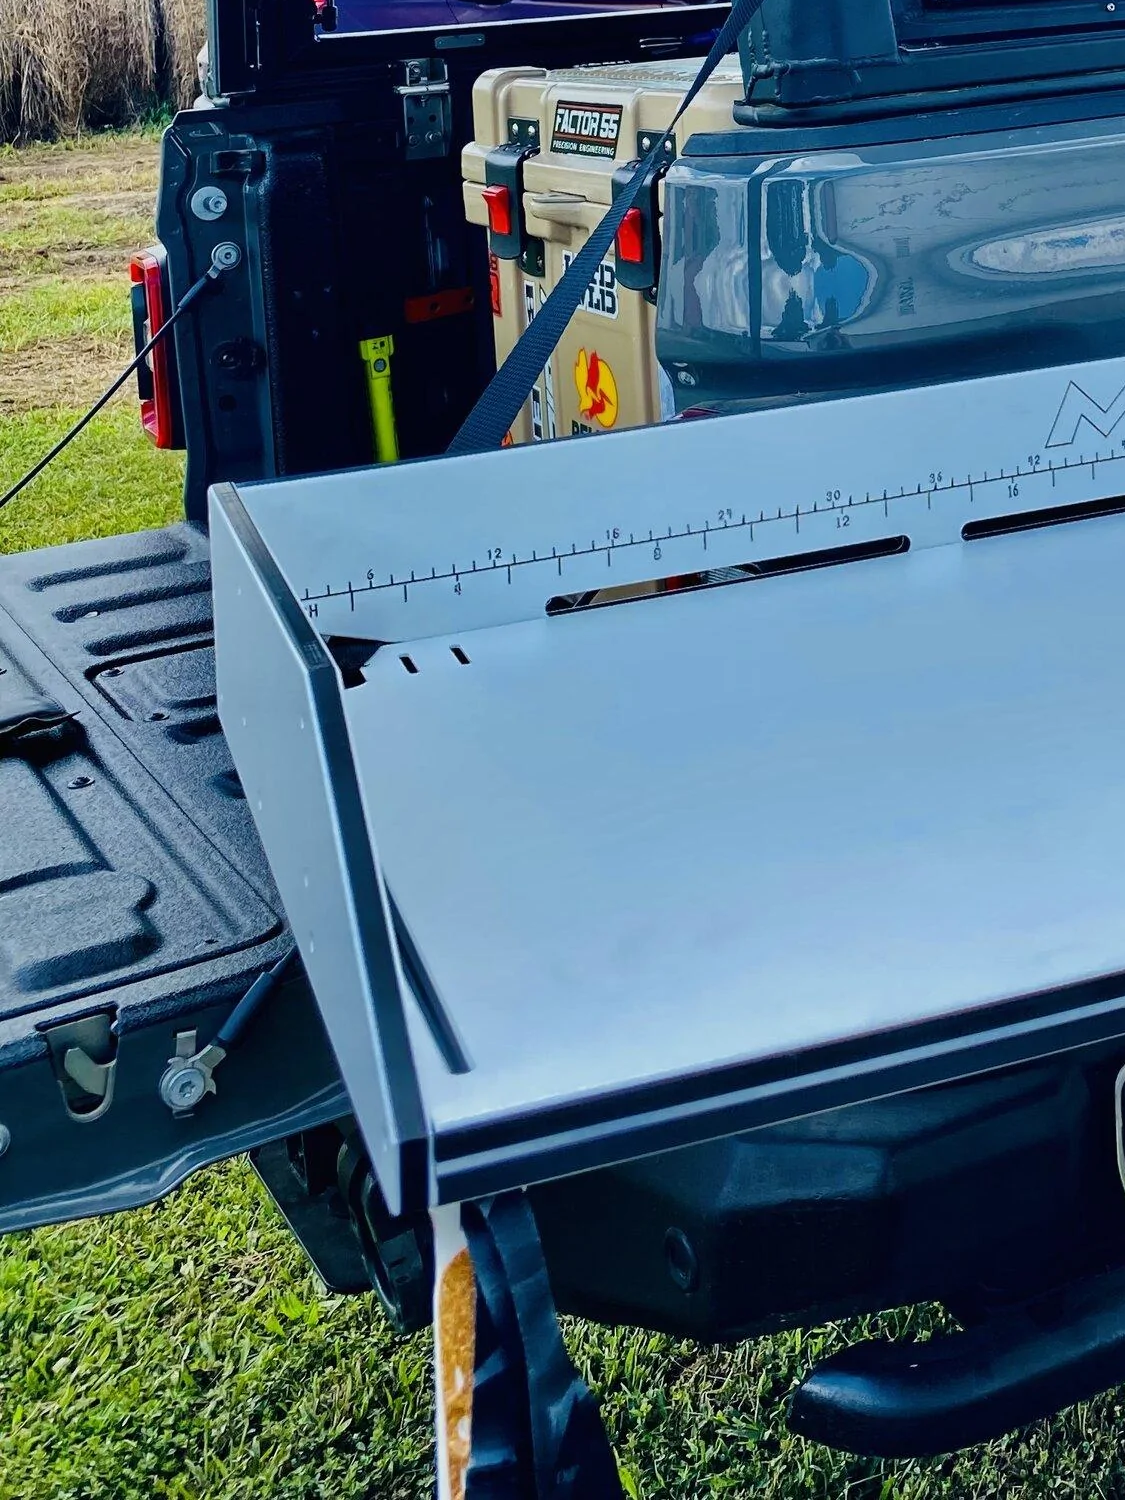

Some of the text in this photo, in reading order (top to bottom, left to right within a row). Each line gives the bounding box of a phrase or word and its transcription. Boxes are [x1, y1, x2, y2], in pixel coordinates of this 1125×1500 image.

[555, 108, 620, 139] FACTOR 55
[552, 140, 614, 155] PRECISION ENGINEERING
[836, 515, 850, 529] 12
[1007, 484, 1019, 498] 16
[367, 569, 374, 580] 6
[488, 548, 502, 560] 12
